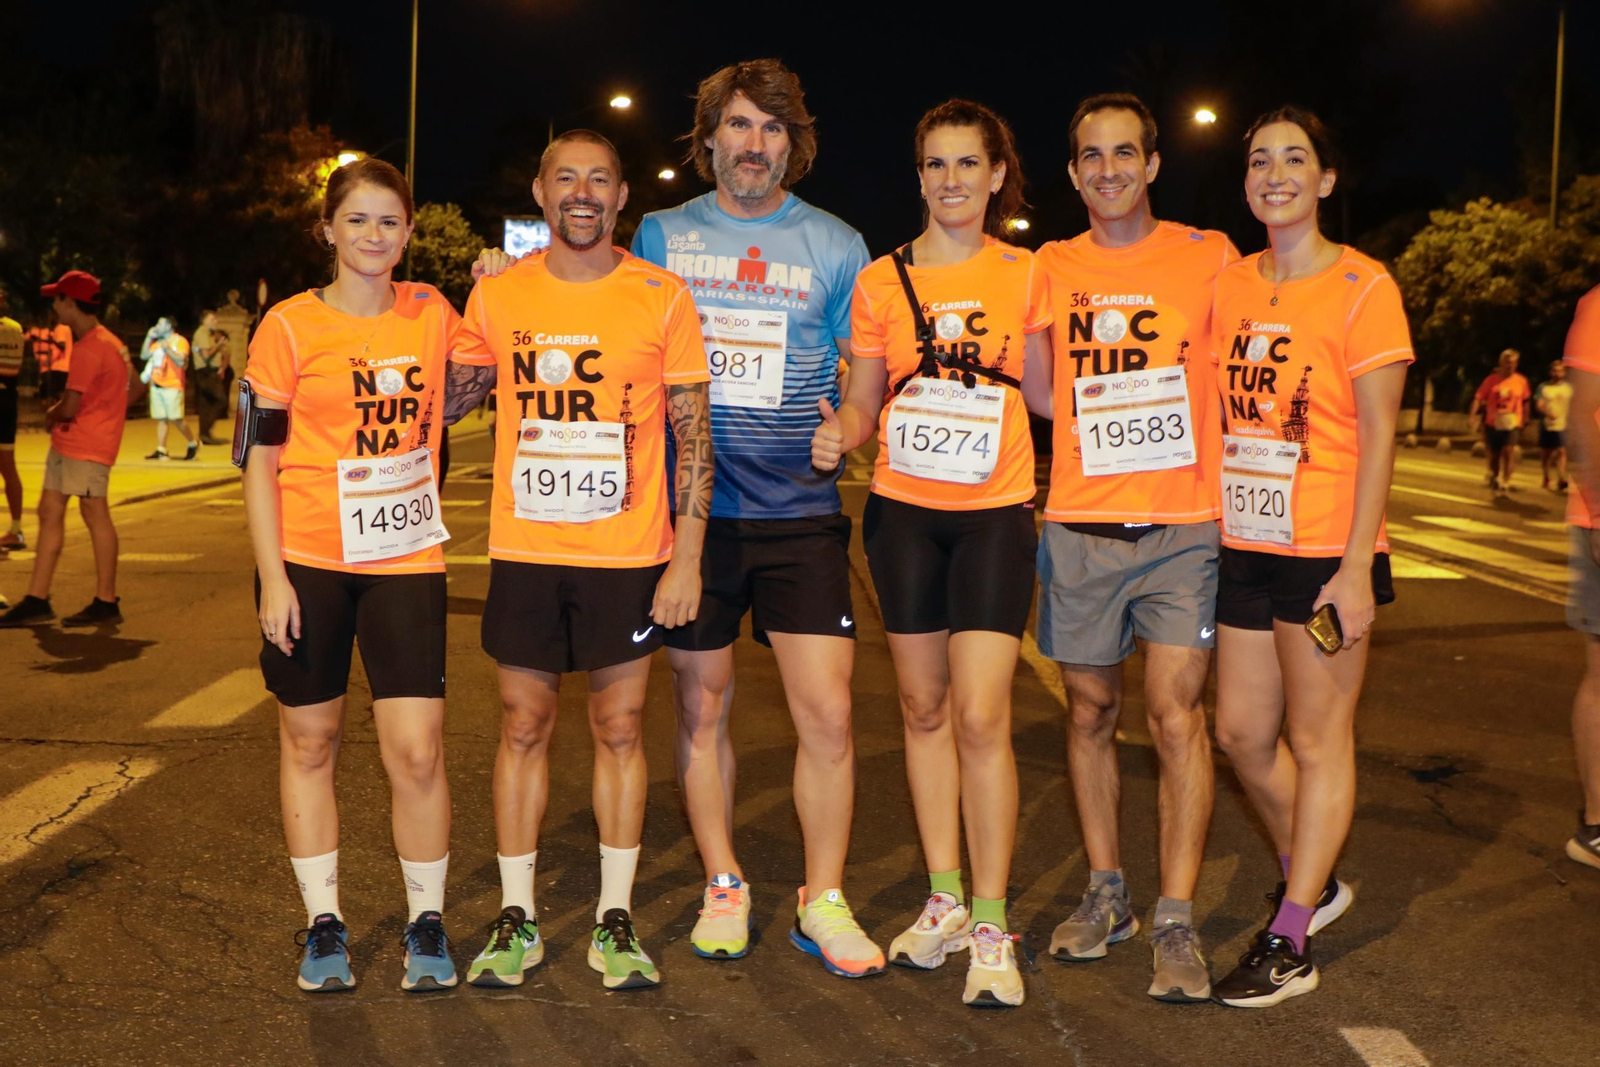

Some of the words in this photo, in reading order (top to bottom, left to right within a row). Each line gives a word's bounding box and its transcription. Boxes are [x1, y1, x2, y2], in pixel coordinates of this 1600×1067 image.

[666, 246, 813, 292] IRONMAN
[682, 277, 809, 302] NZAROTE
[757, 295, 808, 311] SPAIN
[1070, 291, 1090, 308] 36
[1091, 293, 1155, 307] CARRERA
[921, 301, 930, 314] 6
[931, 299, 983, 312] CARRERA
[512, 329, 532, 346] 36
[534, 332, 599, 346] CARRERA
[1238, 318, 1252, 331] 36
[1251, 321, 1291, 334] CARRERA
[348, 357, 368, 368] 36
[368, 354, 418, 368] CARRERA
[709, 350, 763, 380] 981
[1069, 348, 1149, 379] TUR
[1226, 364, 1277, 395] TUR
[354, 397, 419, 427] TUR
[515, 389, 600, 423] TUR
[1228, 394, 1264, 423] NA
[356, 428, 400, 457] NA
[895, 422, 991, 460] 15274
[1088, 413, 1185, 450] 19583
[520, 468, 618, 498] 19145
[351, 493, 434, 535] 14930
[1225, 483, 1285, 518] 15120
